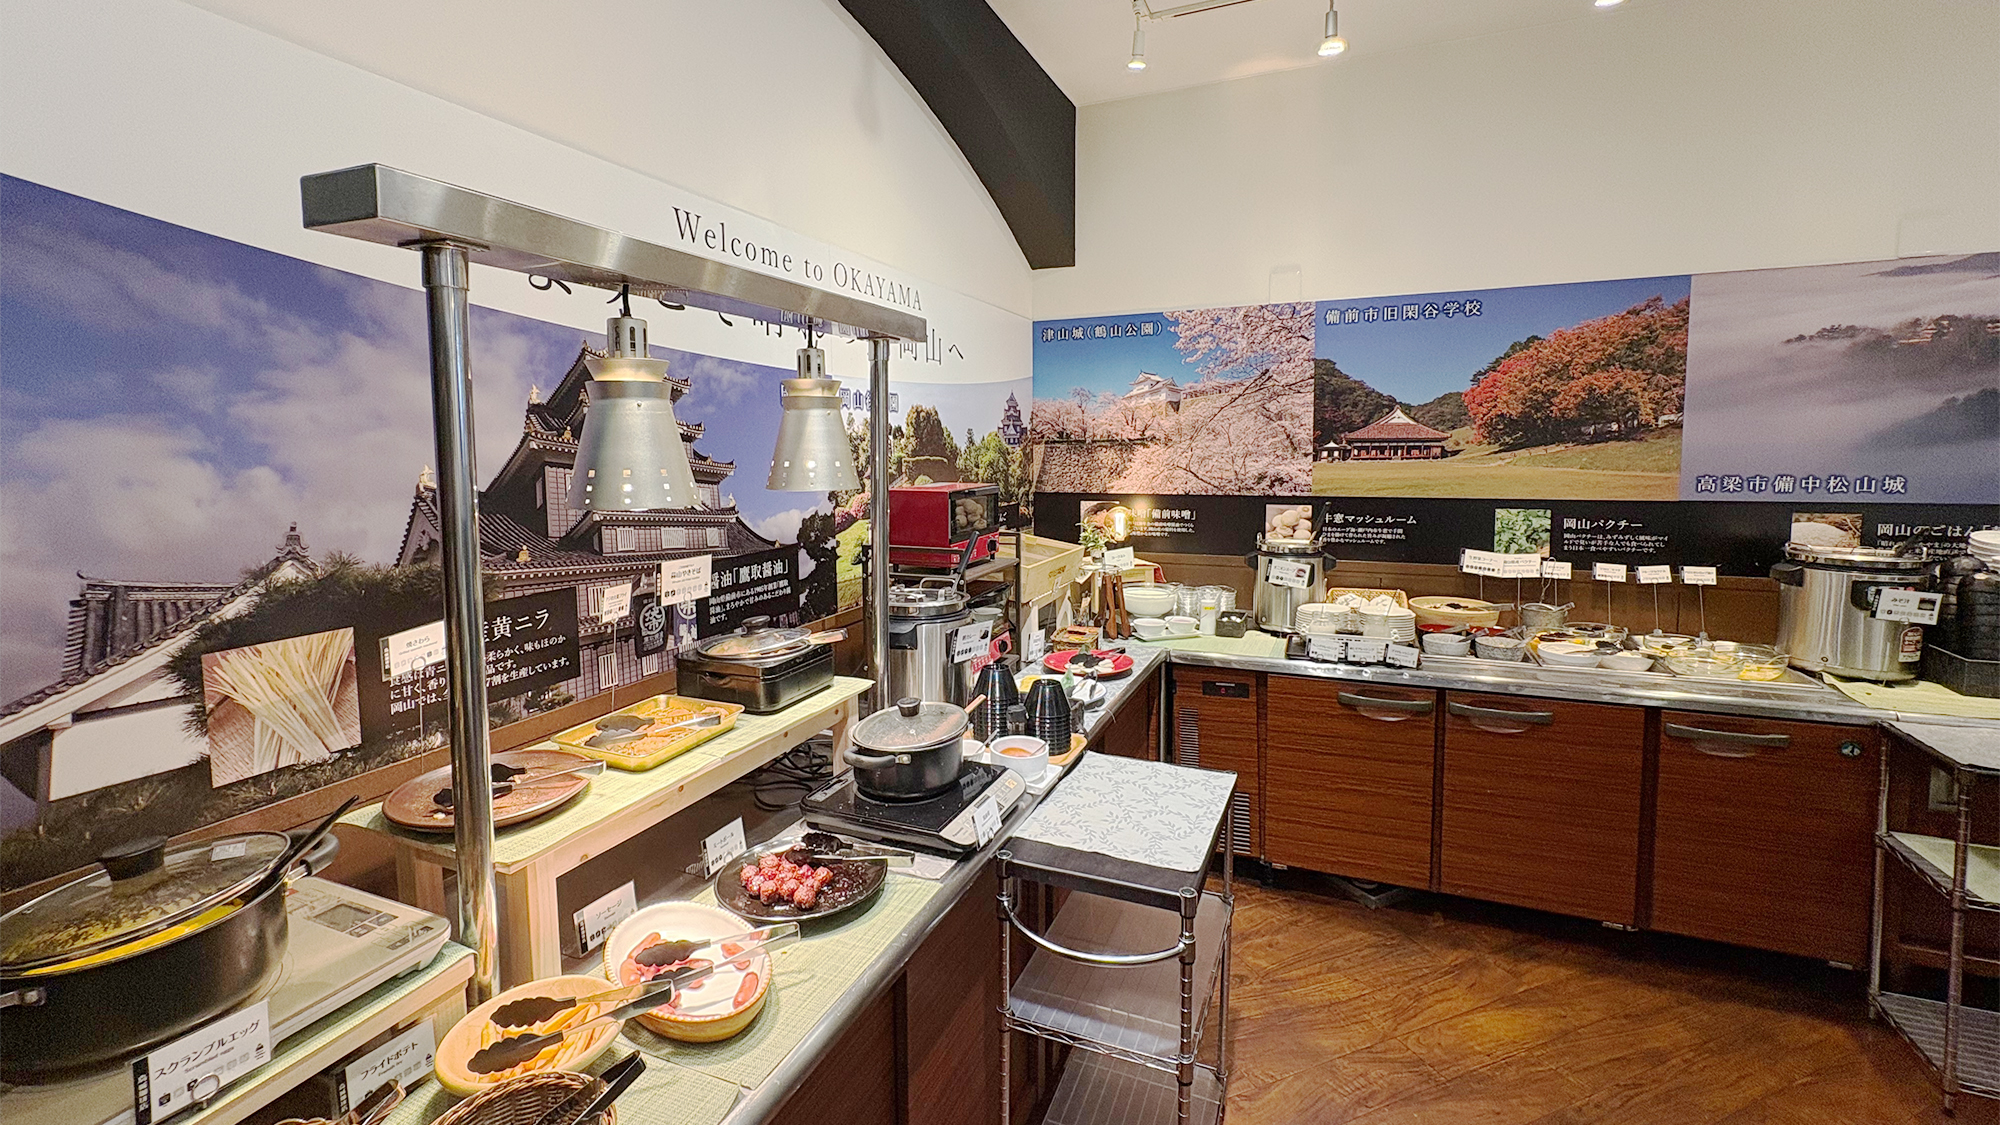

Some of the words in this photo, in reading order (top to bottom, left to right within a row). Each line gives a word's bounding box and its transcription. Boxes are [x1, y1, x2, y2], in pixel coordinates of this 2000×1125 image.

[672, 206, 793, 274] Welcome
[804, 257, 824, 282] to
[833, 262, 923, 312] OKAYAMA
[1325, 300, 1482, 325] 備前市旧閑谷学校
[1041, 321, 1163, 343] 津山城(鶴山公園)
[1696, 475, 1907, 495] 高梁市備中松山城
[1563, 517, 1643, 531] 岡山パクチー
[154, 1018, 260, 1081] スクランブルエッグ
[360, 1042, 418, 1081] フライドポテト
